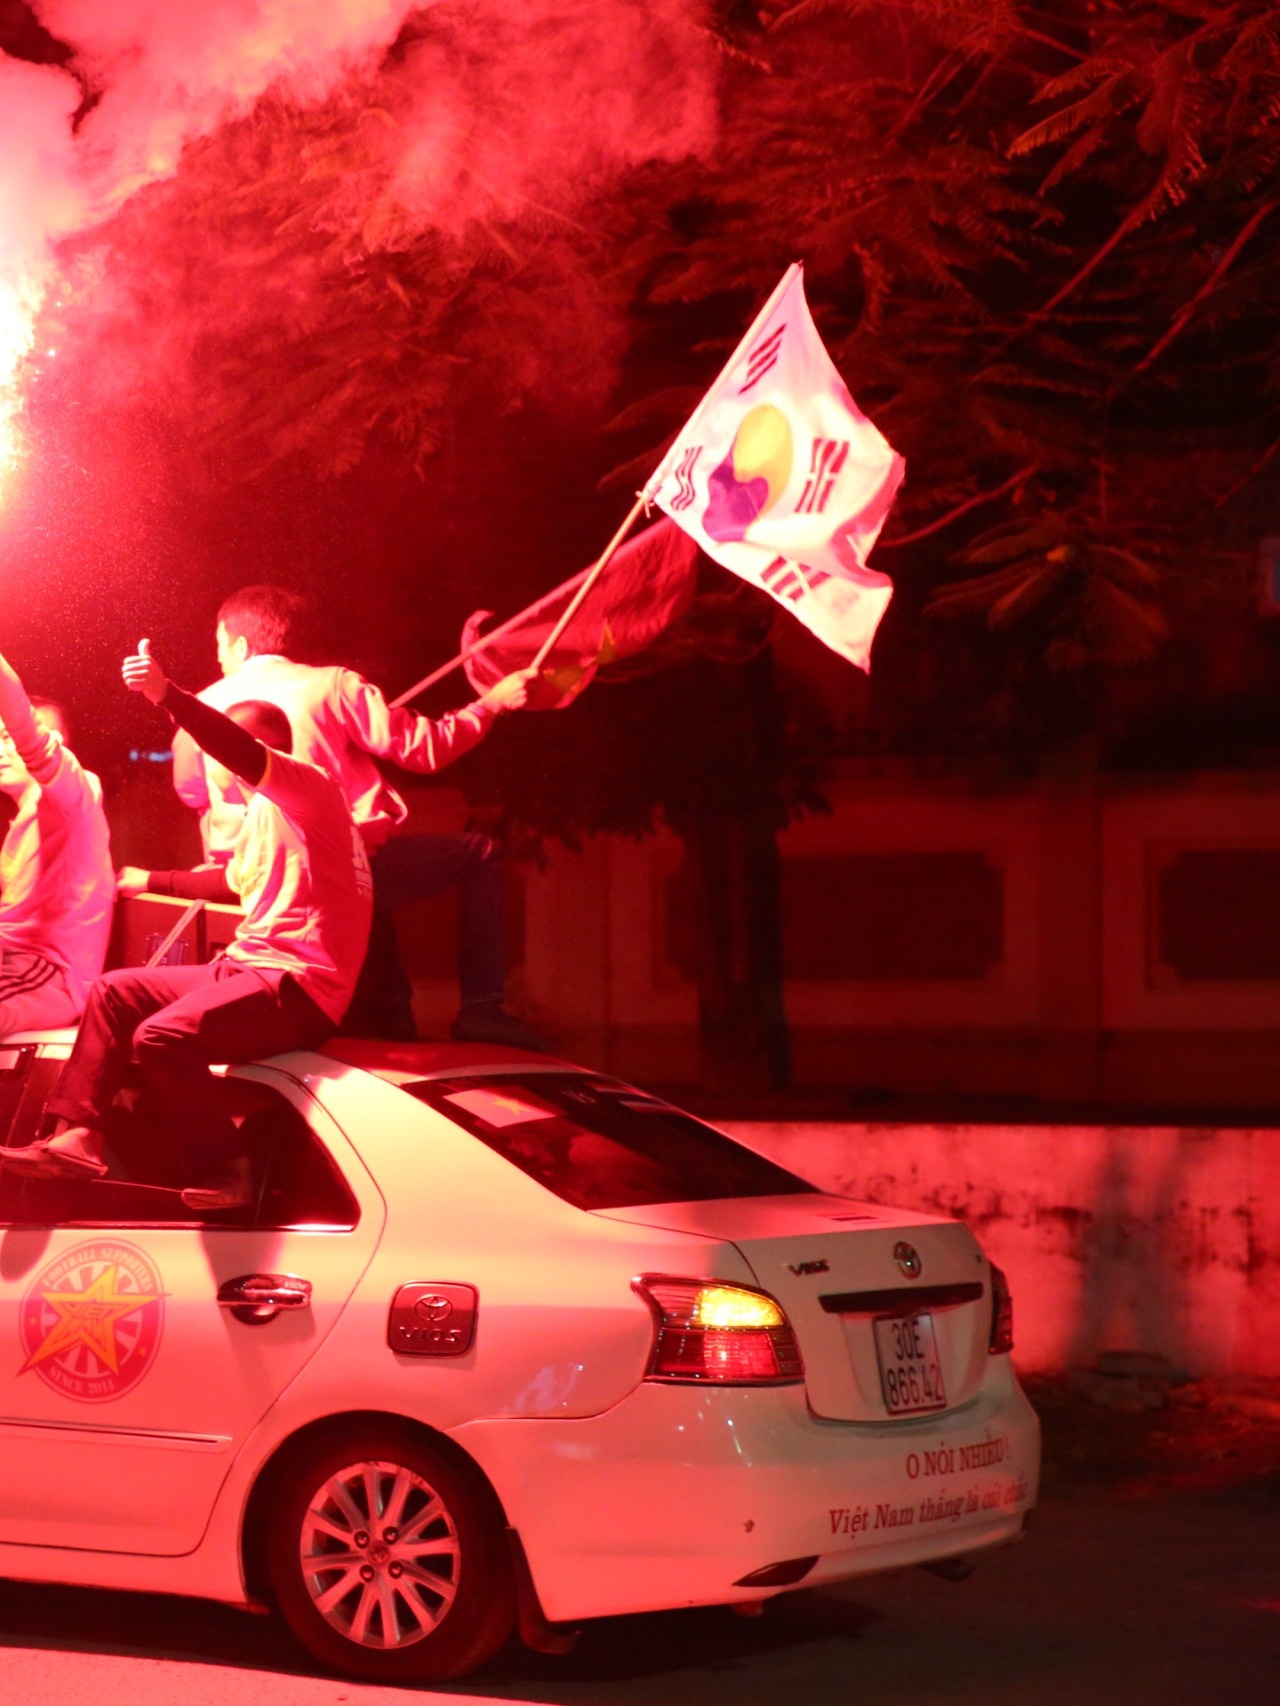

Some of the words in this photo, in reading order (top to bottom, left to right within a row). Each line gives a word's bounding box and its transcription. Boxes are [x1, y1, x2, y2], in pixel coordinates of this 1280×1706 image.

[41, 1247, 97, 1287] FOOTBALL
[100, 1247, 154, 1292] SUPPORTERS
[399, 1326, 462, 1342] VIOS
[891, 1320, 925, 1360] 30E
[47, 1365, 83, 1393] SINCE
[887, 1362, 944, 1407] 866.42
[923, 1440, 956, 1476] NÓI
[829, 1505, 869, 1540] Việt
[873, 1503, 914, 1529] Nam
[919, 1487, 965, 1523] thắng
